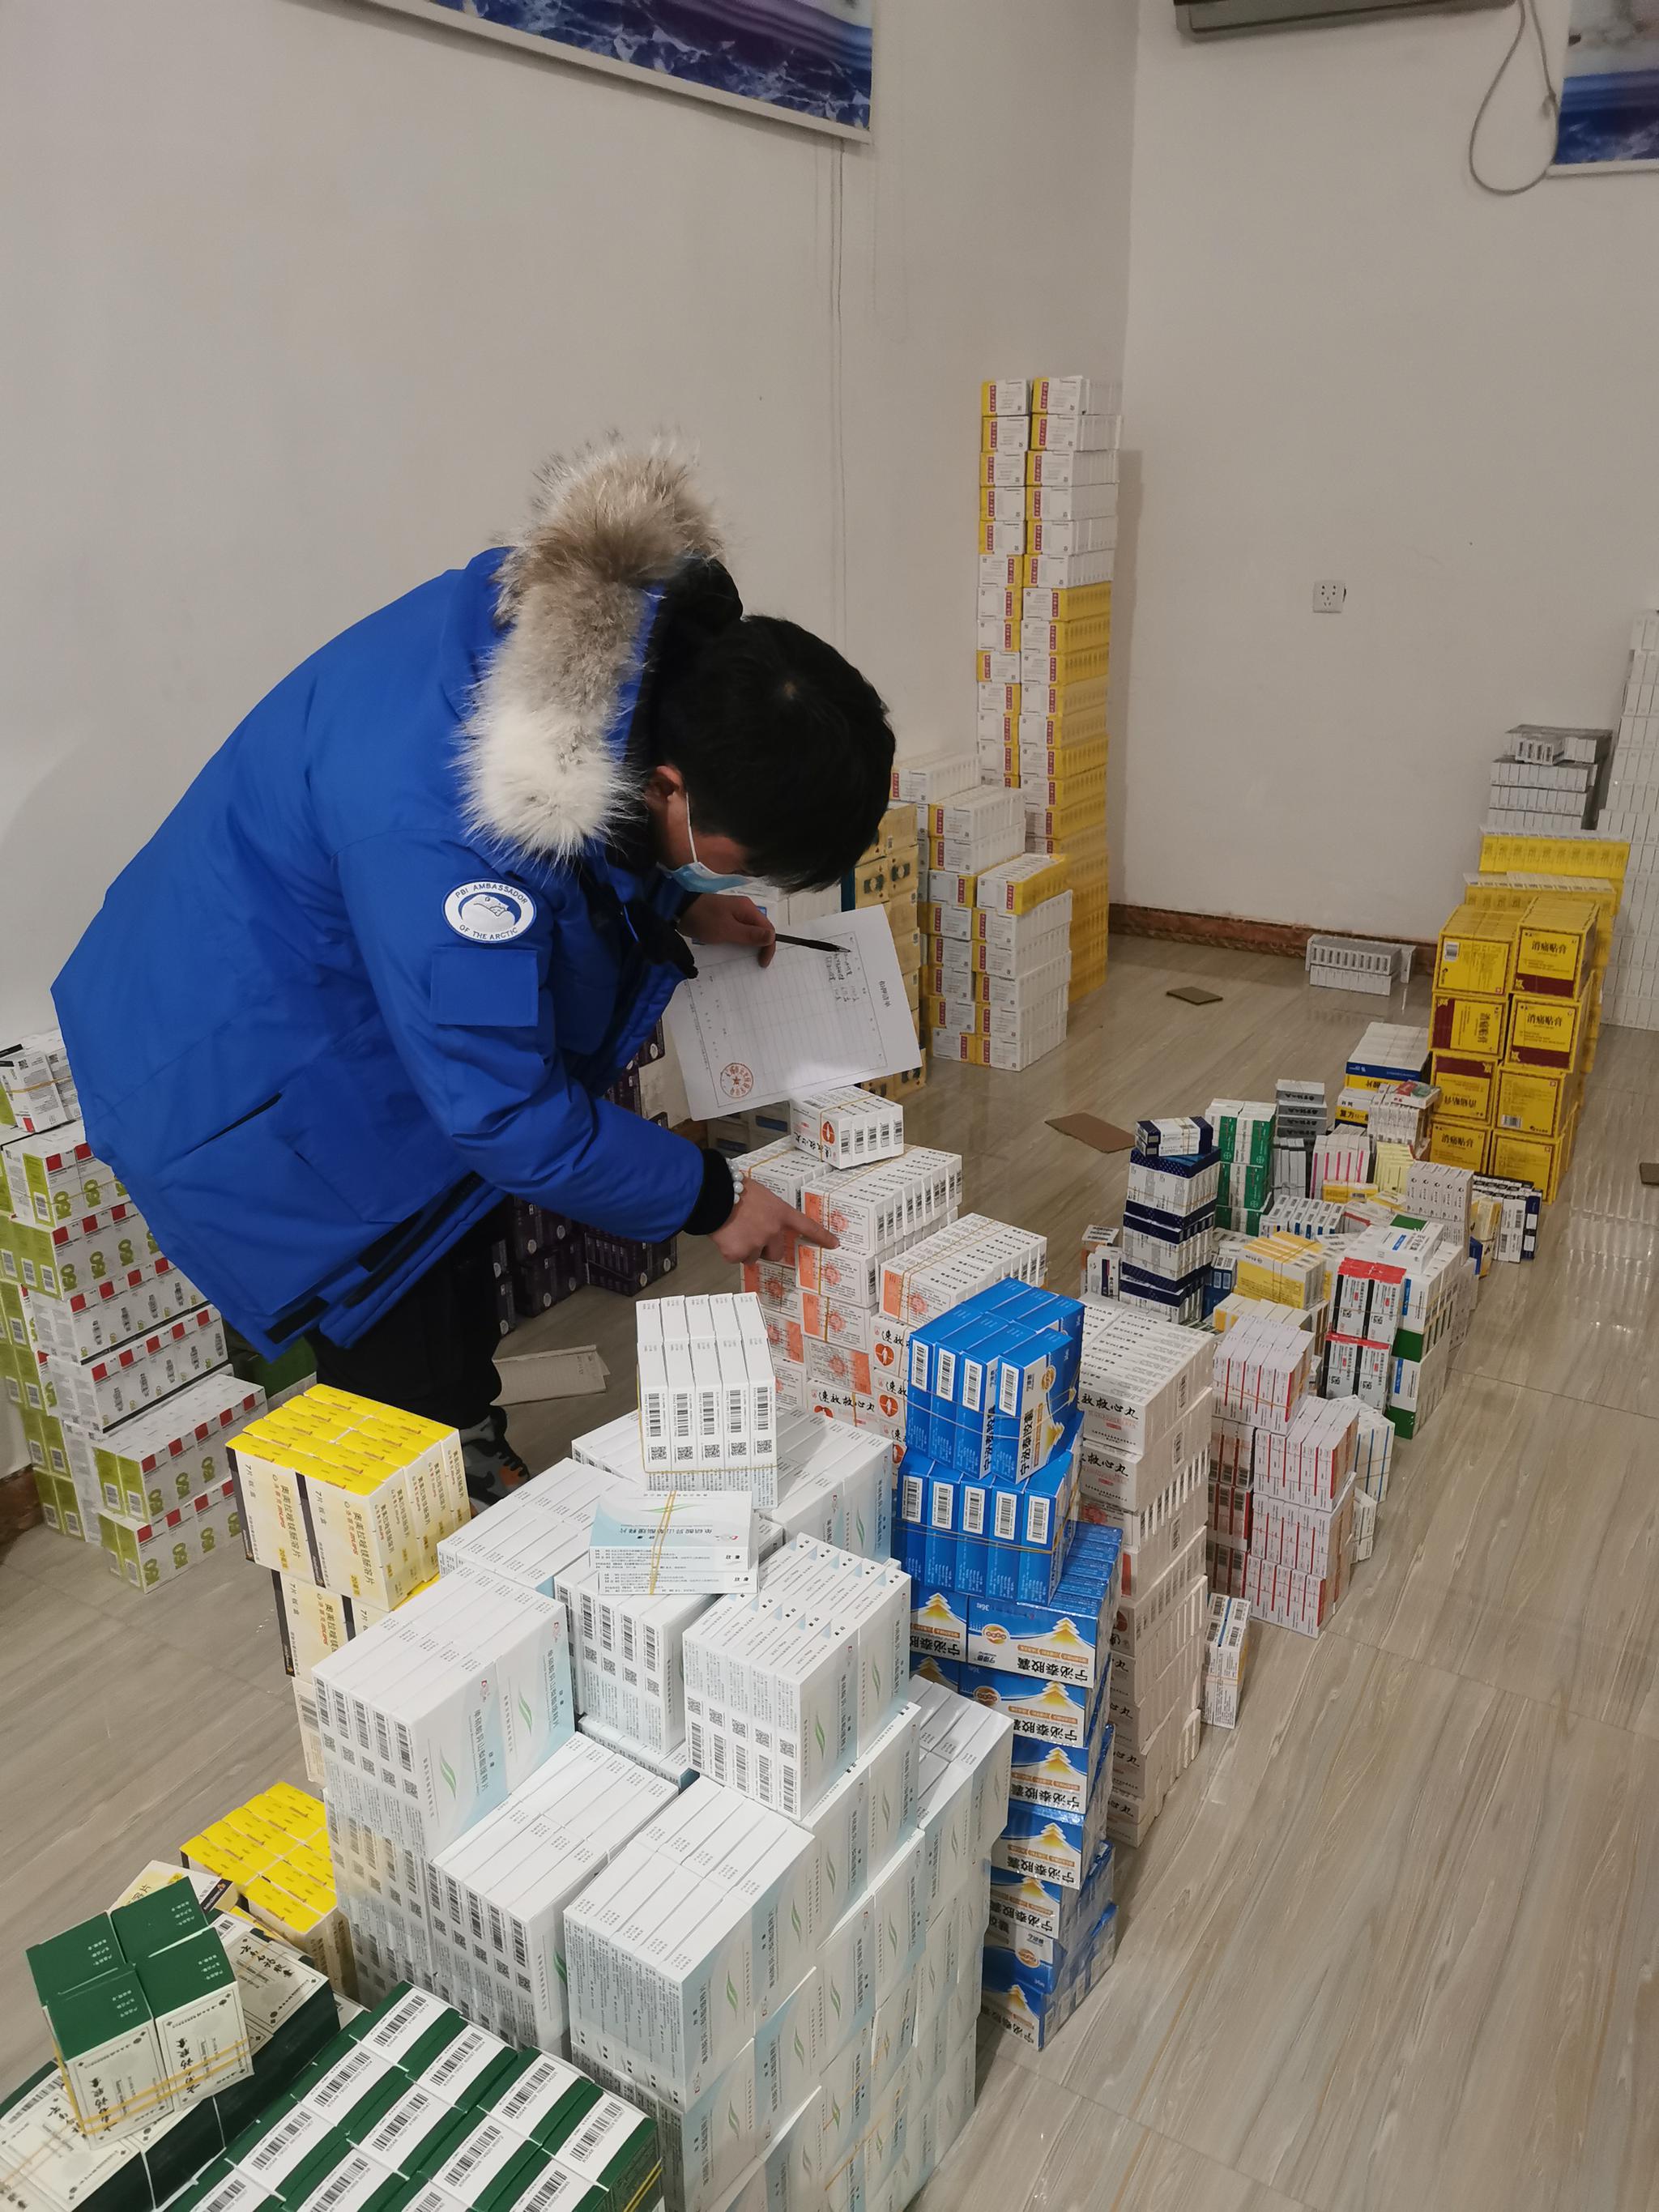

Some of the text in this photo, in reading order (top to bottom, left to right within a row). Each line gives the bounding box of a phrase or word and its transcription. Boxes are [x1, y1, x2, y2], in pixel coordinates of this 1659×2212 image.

[454, 883, 529, 905] PBI AMBASSADOR
[458, 924, 519, 940] OF THE ARCTIC
[1531, 940, 1567, 955] 消痛贴膏
[1526, 1013, 1563, 1027] 消痛贴膏
[1441, 1134, 1474, 1147] 消痛贴膏
[818, 1390, 876, 1413] 速效救心丸
[279, 1484, 301, 1559] 奥美拉唑镁肠溶片
[352, 1511, 375, 1586] 奥美拉唑镁肠溶片
[1017, 1656, 1088, 1682] 宁泌泰胶囊
[1010, 1784, 1080, 1808] 宁泌泰胶囊
[1007, 1856, 1074, 1883] 宁泌泰胶囊
